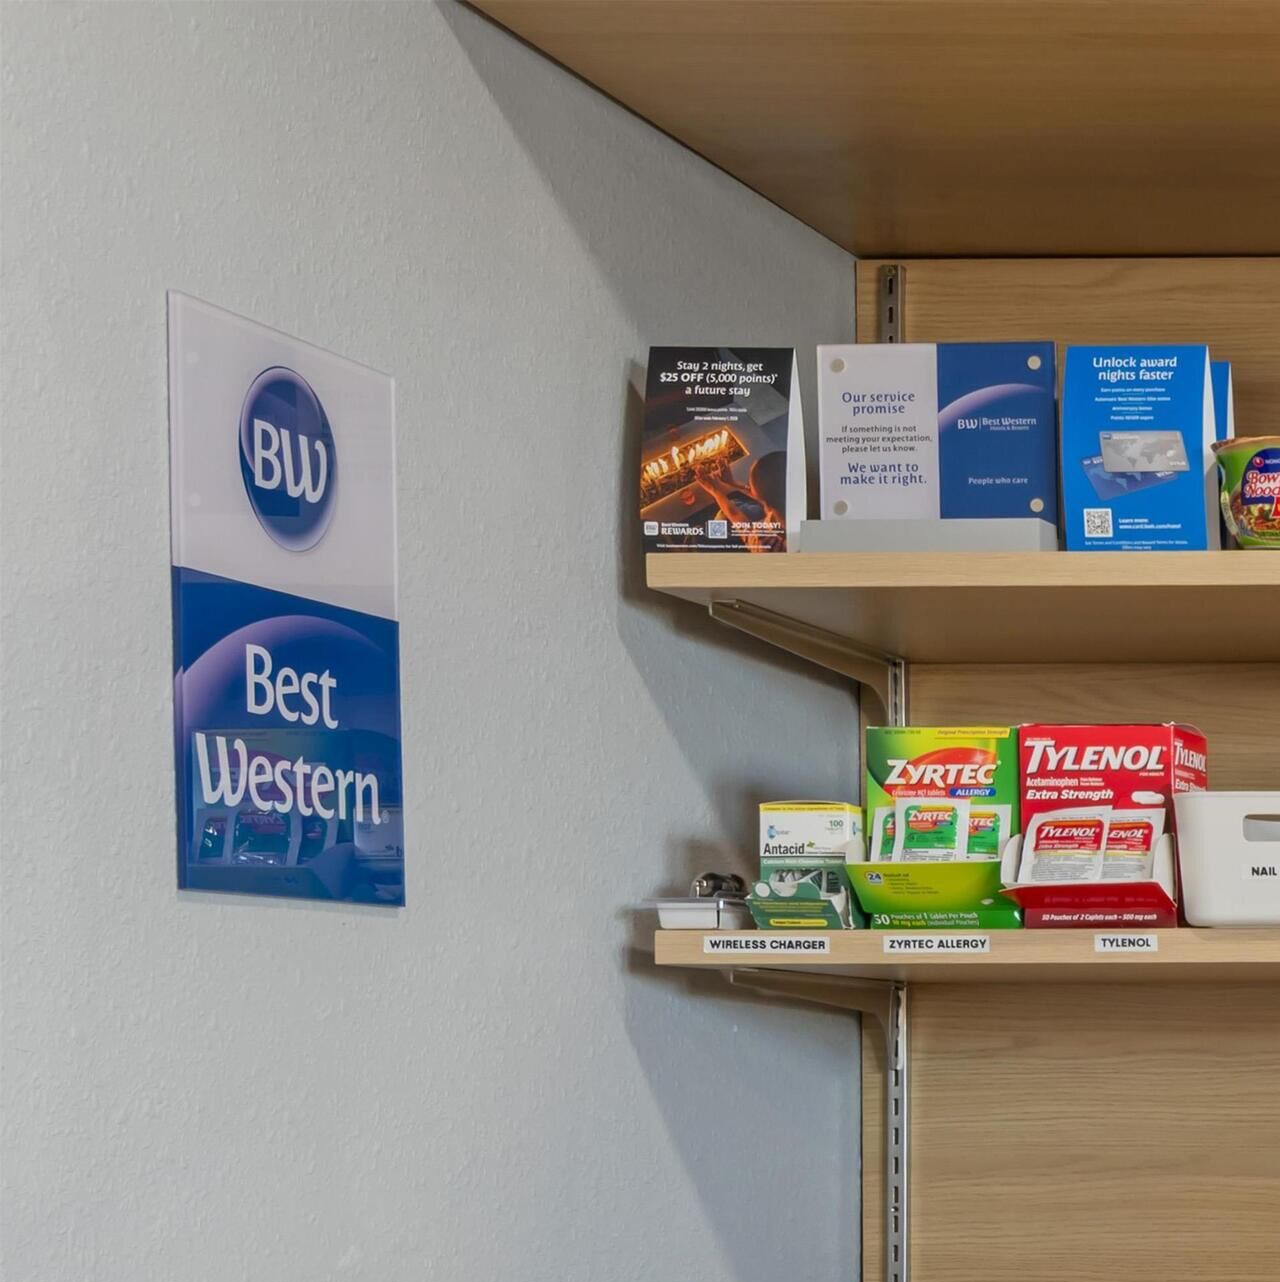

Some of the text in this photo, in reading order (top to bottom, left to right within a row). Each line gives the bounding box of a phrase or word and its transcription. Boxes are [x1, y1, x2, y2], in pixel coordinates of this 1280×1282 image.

[677, 361, 763, 374] Stay 2 nights, get
[1093, 357, 1177, 368] Unlock award
[660, 372, 678, 383] $25
[681, 373, 704, 383] OFF
[706, 373, 736, 384] (5,000
[1098, 369, 1174, 382] nights faster
[694, 385, 726, 395] future
[729, 386, 750, 397] stay
[842, 392, 915, 403] Our service
[852, 404, 905, 416] promise
[957, 417, 1037, 430] BW Best Western
[841, 425, 917, 435] If something is not
[826, 435, 859, 445] meeting
[861, 437, 880, 445] your
[842, 445, 869, 454] please
[870, 445, 881, 453] let
[252, 418, 328, 503] BW
[847, 462, 919, 473] We want to
[840, 474, 927, 487] make it right.
[968, 477, 993, 487] People
[994, 477, 1011, 485] who
[661, 527, 704, 536] REWARDS
[245, 644, 338, 729] Best
[1024, 739, 1164, 774] TYLENOL
[195, 731, 382, 825] Western
[885, 759, 997, 788] ZYRTEC
[1026, 777, 1079, 788] Acetaminophen
[955, 788, 991, 797] ALLERGY
[1026, 789, 1114, 801] Extra Strength
[908, 810, 954, 822] ZYRTEC
[828, 820, 844, 828] 100
[1039, 826, 1096, 837] TYLENOL
[763, 842, 805, 856] Antacid
[1251, 866, 1277, 877] NAIL
[709, 939, 826, 950] WIRELESS CHARGER
[889, 939, 987, 949] ZYRTEC ALLERGY
[1101, 938, 1151, 948] TYLENOL
